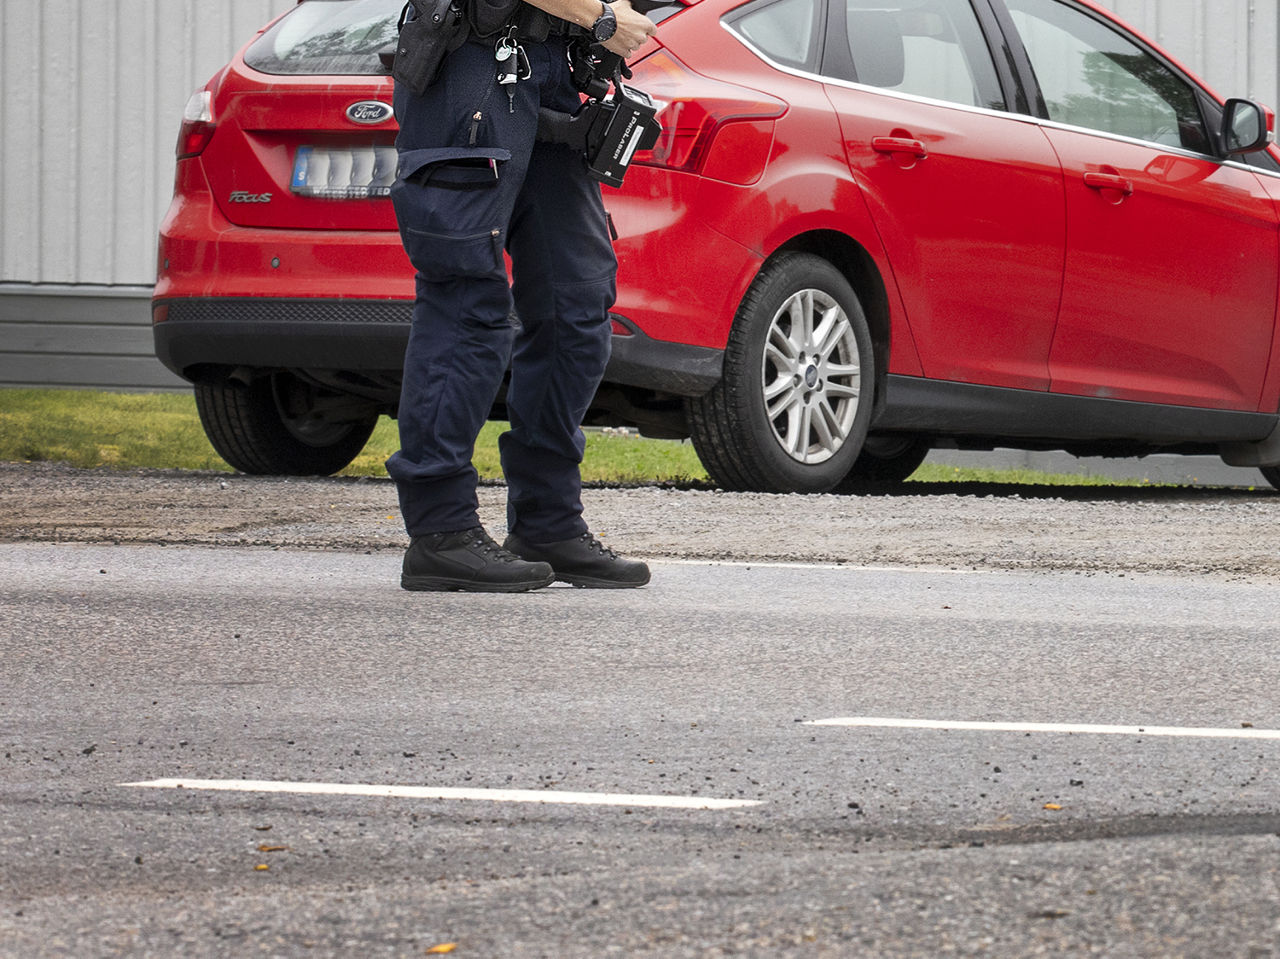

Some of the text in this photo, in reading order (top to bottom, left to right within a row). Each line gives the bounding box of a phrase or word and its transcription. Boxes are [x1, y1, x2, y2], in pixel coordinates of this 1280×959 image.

[354, 105, 382, 120] Ford
[298, 171, 305, 181] S
[228, 190, 273, 204] FOCUS
